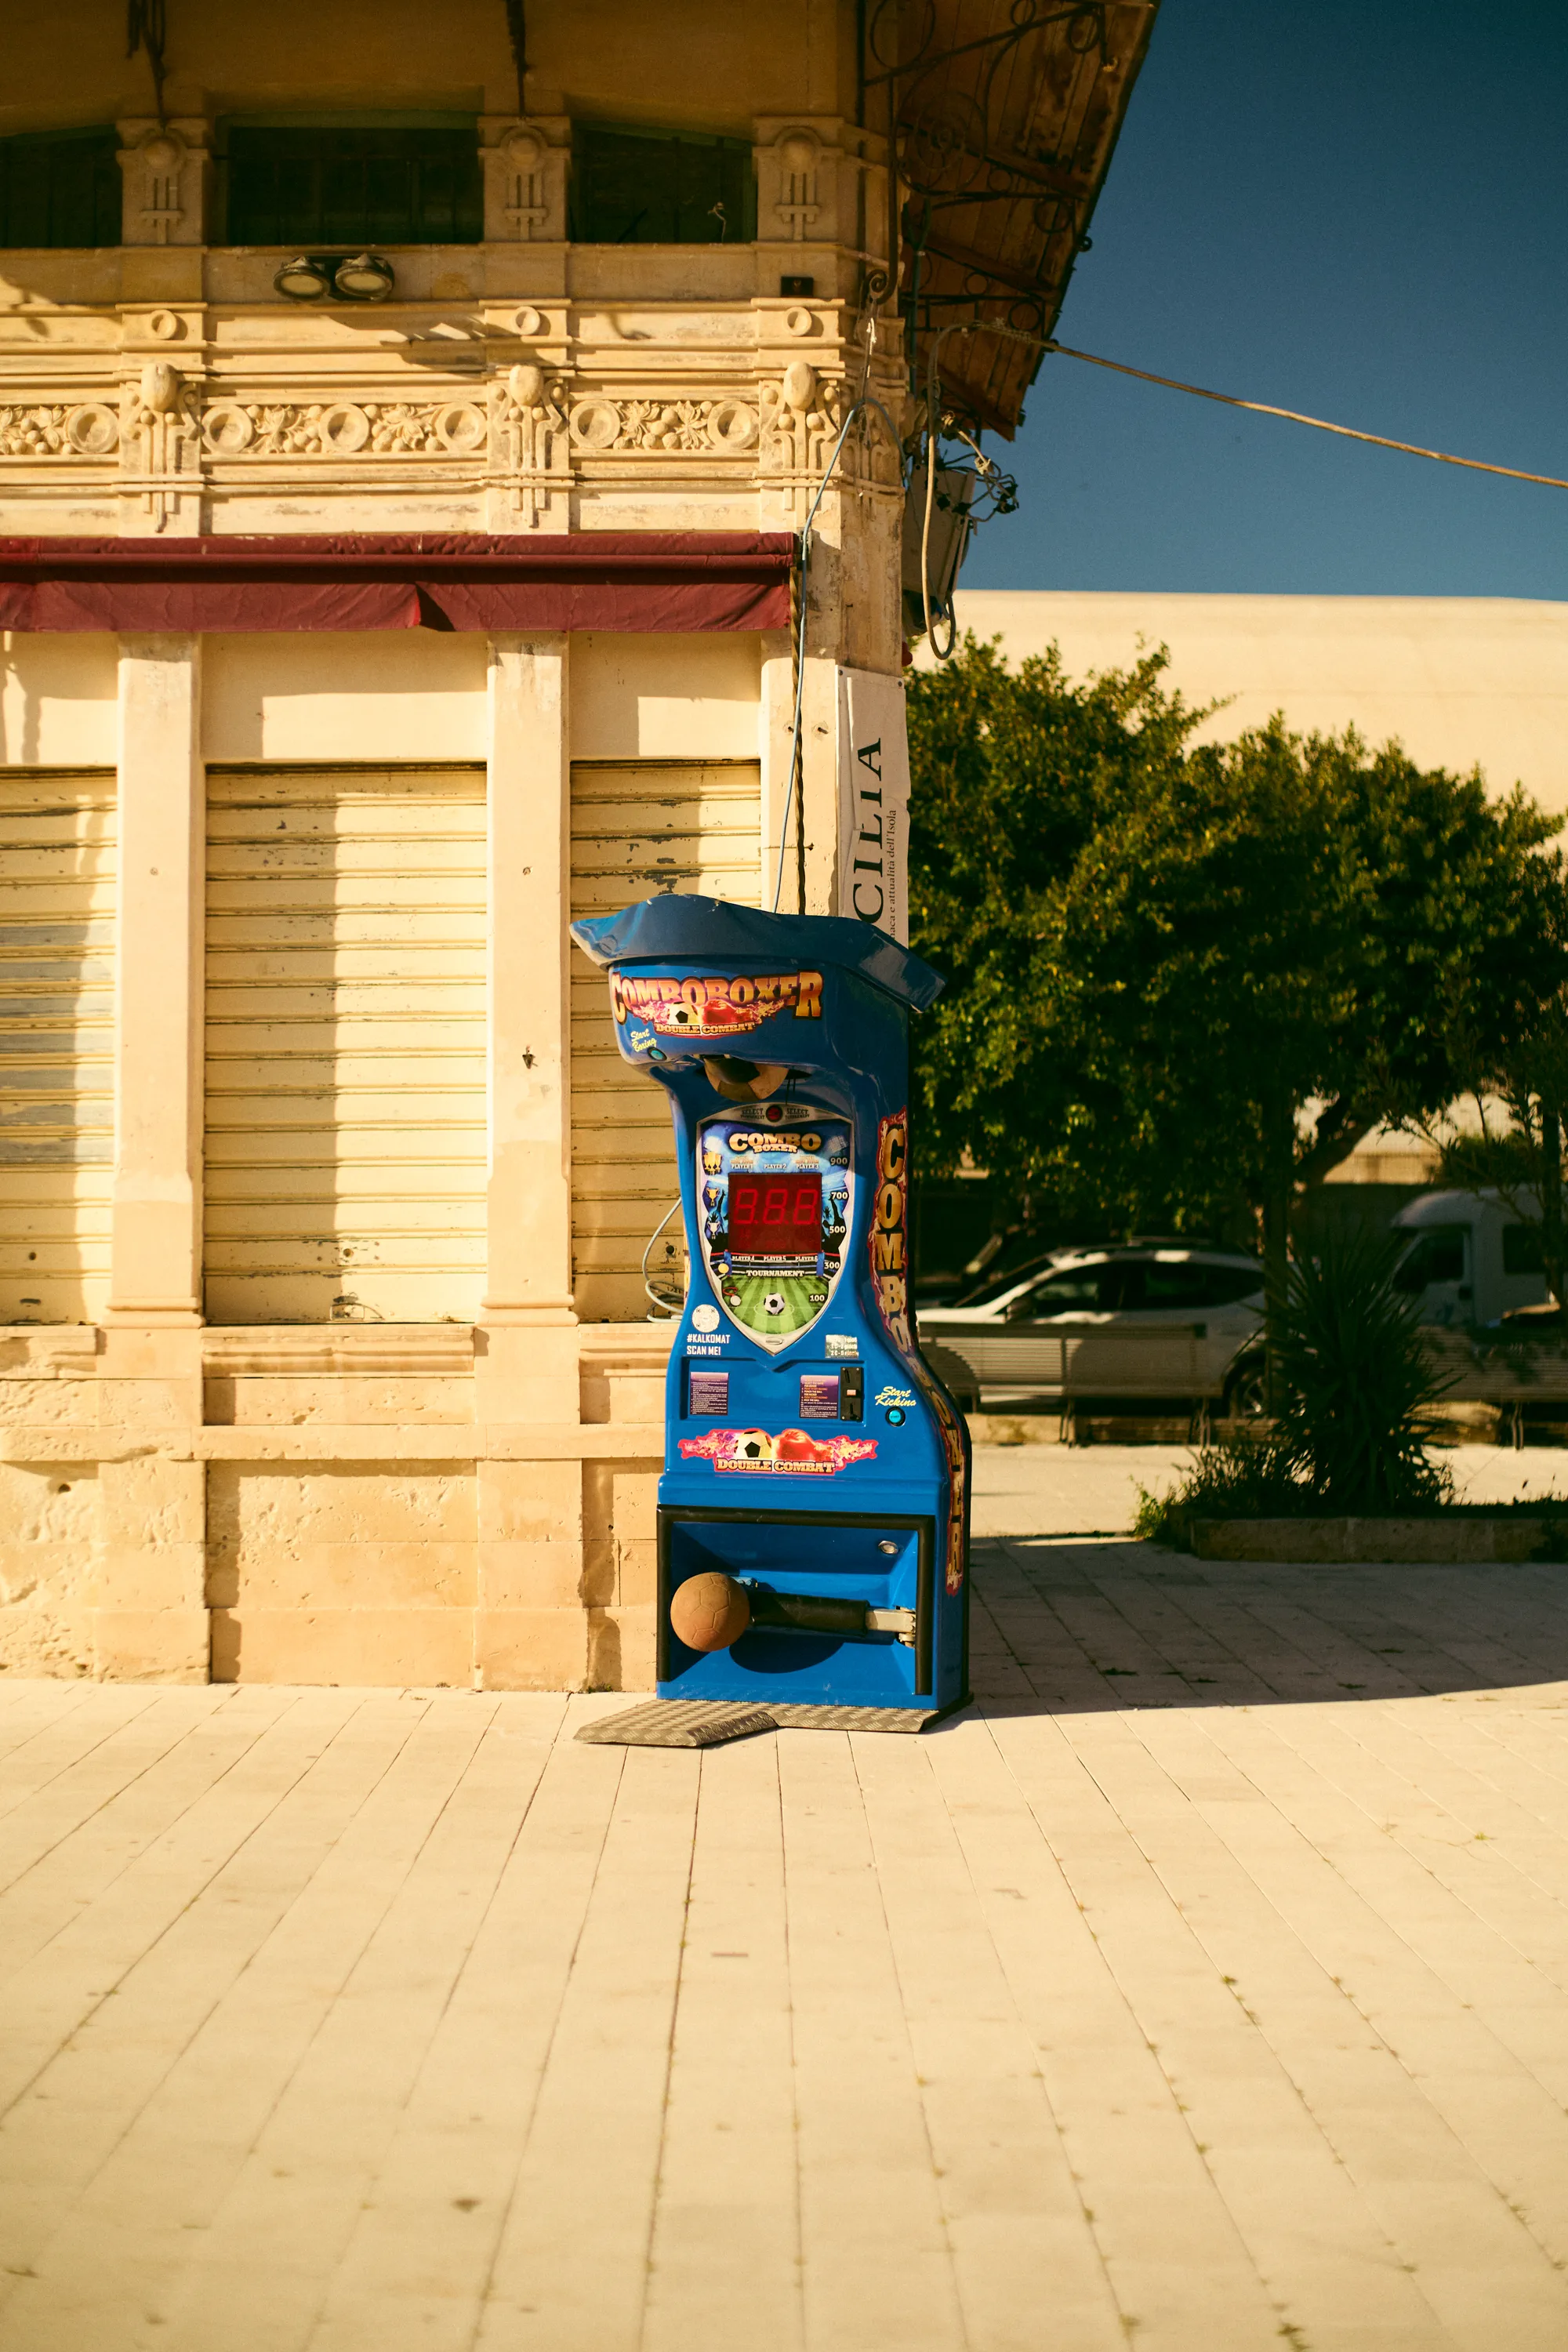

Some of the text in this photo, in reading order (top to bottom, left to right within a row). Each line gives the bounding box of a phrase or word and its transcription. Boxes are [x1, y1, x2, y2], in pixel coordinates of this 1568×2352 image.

[886, 810, 897, 858] dell'Isola
[887, 862, 895, 905] attualità
[655, 1022, 756, 1034] DOUBLE COMBAT
[630, 1028, 650, 1042] Start
[631, 1037, 657, 1052] Boxing
[728, 1132, 822, 1152] COMBO
[753, 1144, 798, 1154] BOXER
[829, 1156, 848, 1166] 900
[831, 1191, 848, 1200] 700
[829, 1225, 846, 1234] 500
[876, 1127, 908, 1352] COMBO
[687, 1334, 731, 1344] #KALKOMAT
[686, 1345, 721, 1356] SCAN ME!
[880, 1386, 912, 1397] Start
[717, 1458, 835, 1473] DOUBLE COMBAT
